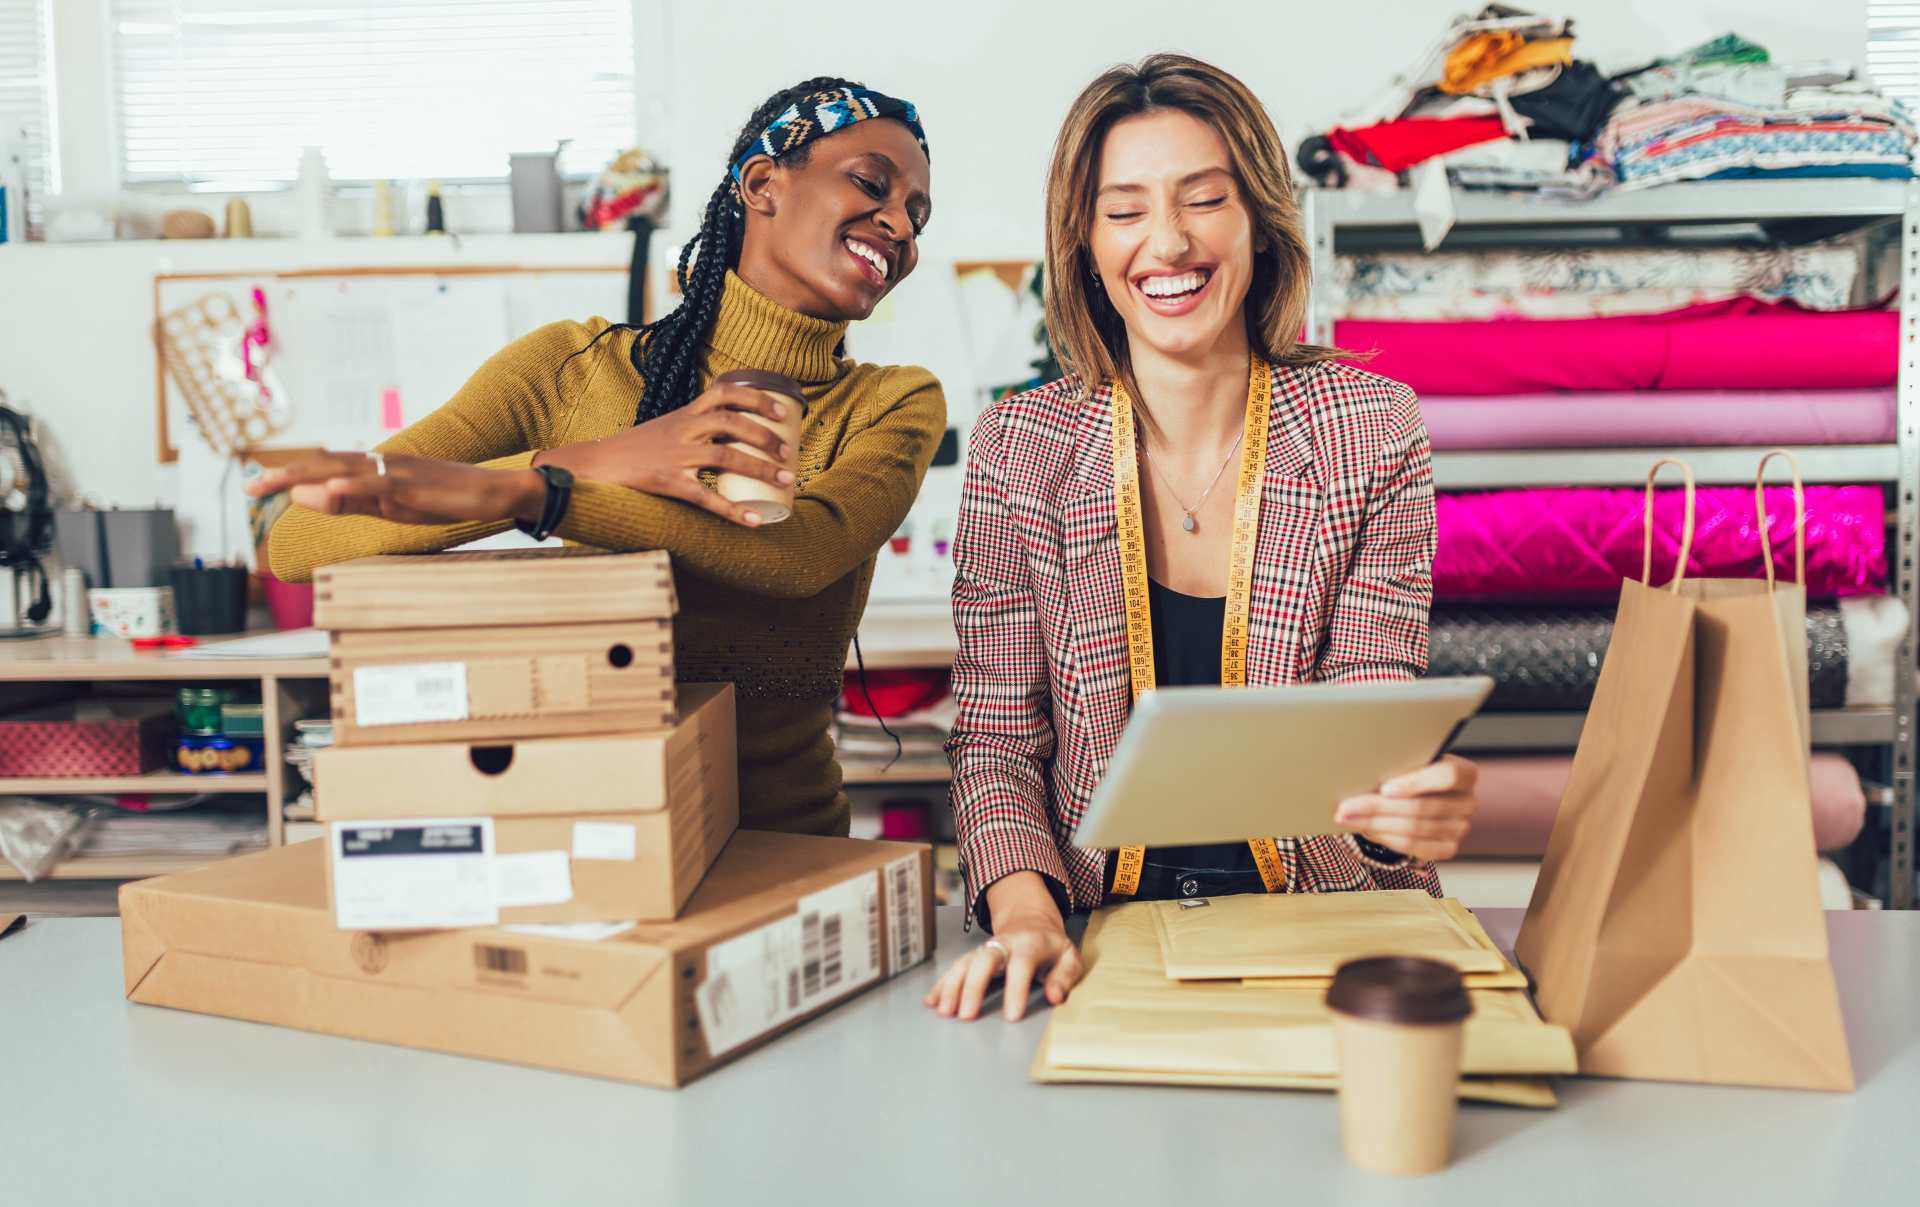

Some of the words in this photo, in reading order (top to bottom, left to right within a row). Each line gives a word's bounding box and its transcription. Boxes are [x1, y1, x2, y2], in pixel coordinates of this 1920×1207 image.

[1258, 382, 1266, 390] 61
[1256, 392, 1265, 401] 60
[1117, 405, 1124, 413] 87
[1255, 404, 1263, 413] 59
[1254, 416, 1263, 424] 58
[1118, 427, 1126, 435] 89
[1252, 427, 1261, 436] 57
[1118, 438, 1126, 446] 90
[1251, 438, 1260, 447] 56
[1250, 450, 1259, 459] 55
[1249, 462, 1258, 471] 54
[1247, 474, 1257, 482] 53
[1121, 483, 1130, 491] 94
[1122, 495, 1131, 503] 95
[1125, 518, 1133, 526] 97
[1126, 529, 1134, 538] 98
[1127, 541, 1135, 549] 99
[1125, 553, 1136, 561] 100
[1126, 564, 1136, 572] 101
[1127, 576, 1138, 584] 102
[1128, 587, 1139, 596] 103
[1129, 599, 1141, 607] 104
[1130, 611, 1141, 619] 105
[1131, 622, 1142, 630] 106
[1231, 627, 1240, 635] 40
[1132, 634, 1143, 642] 107
[1231, 638, 1240, 647] 39
[1133, 645, 1144, 653] 108
[1230, 649, 1239, 658] 38
[1134, 656, 1145, 665] 109
[1230, 660, 1239, 669] 37
[1135, 668, 1146, 676] 110
[1230, 672, 1240, 680] 36
[1136, 680, 1146, 688] 111
[1261, 847, 1270, 855] 20
[1124, 851, 1135, 860] 126
